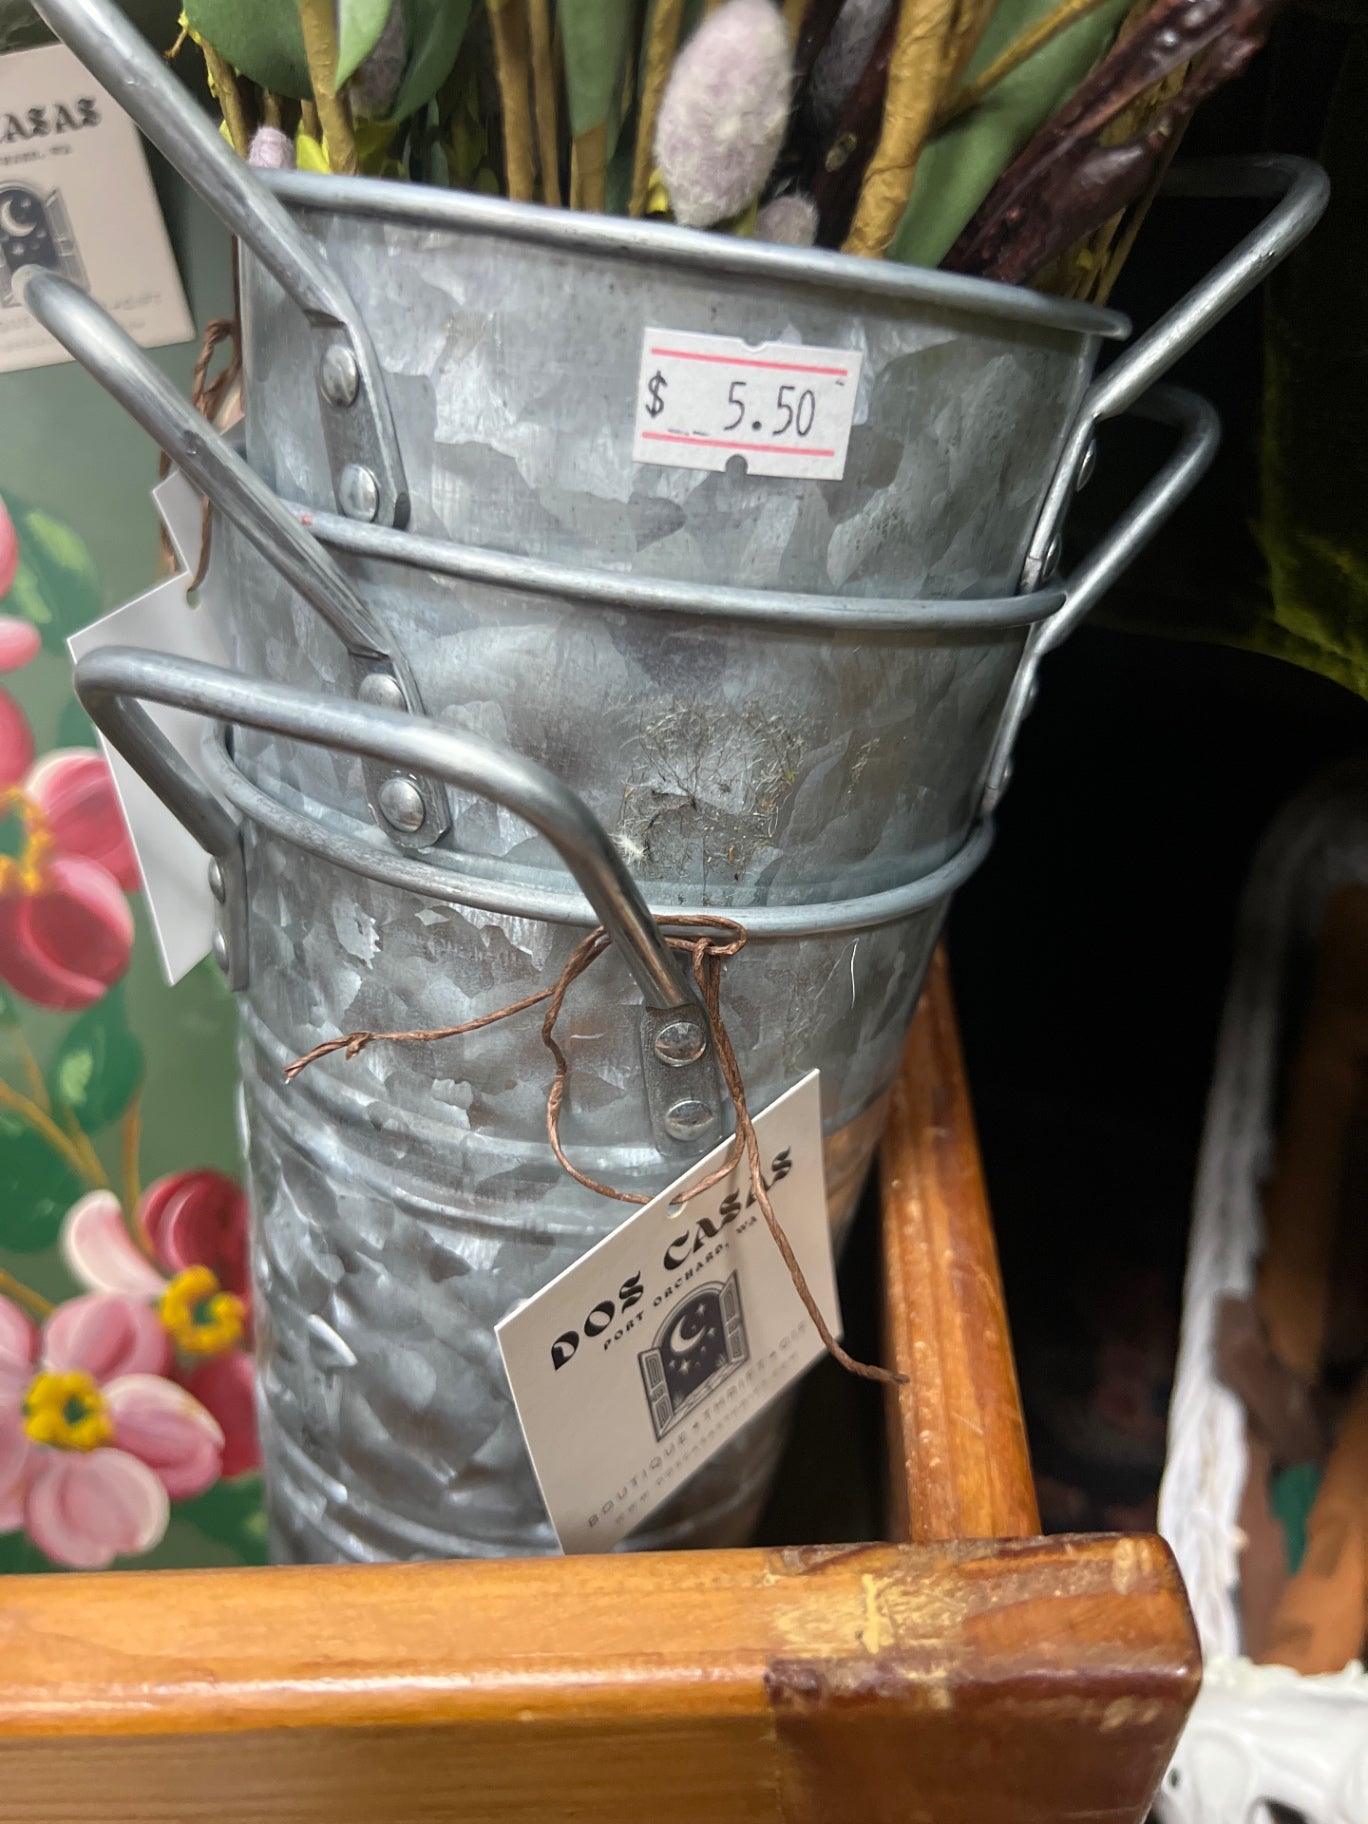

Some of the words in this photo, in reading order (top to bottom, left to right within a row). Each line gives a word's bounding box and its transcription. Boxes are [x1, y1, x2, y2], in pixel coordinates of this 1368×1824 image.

[0, 97, 101, 143] ASAS
[645, 370, 667, 418] $
[723, 381, 816, 437] 5.50
[551, 1271, 644, 1371] DOS
[603, 1310, 645, 1351] PORT
[653, 1243, 729, 1307] ORCHARD,
[736, 1216, 757, 1234] WA
